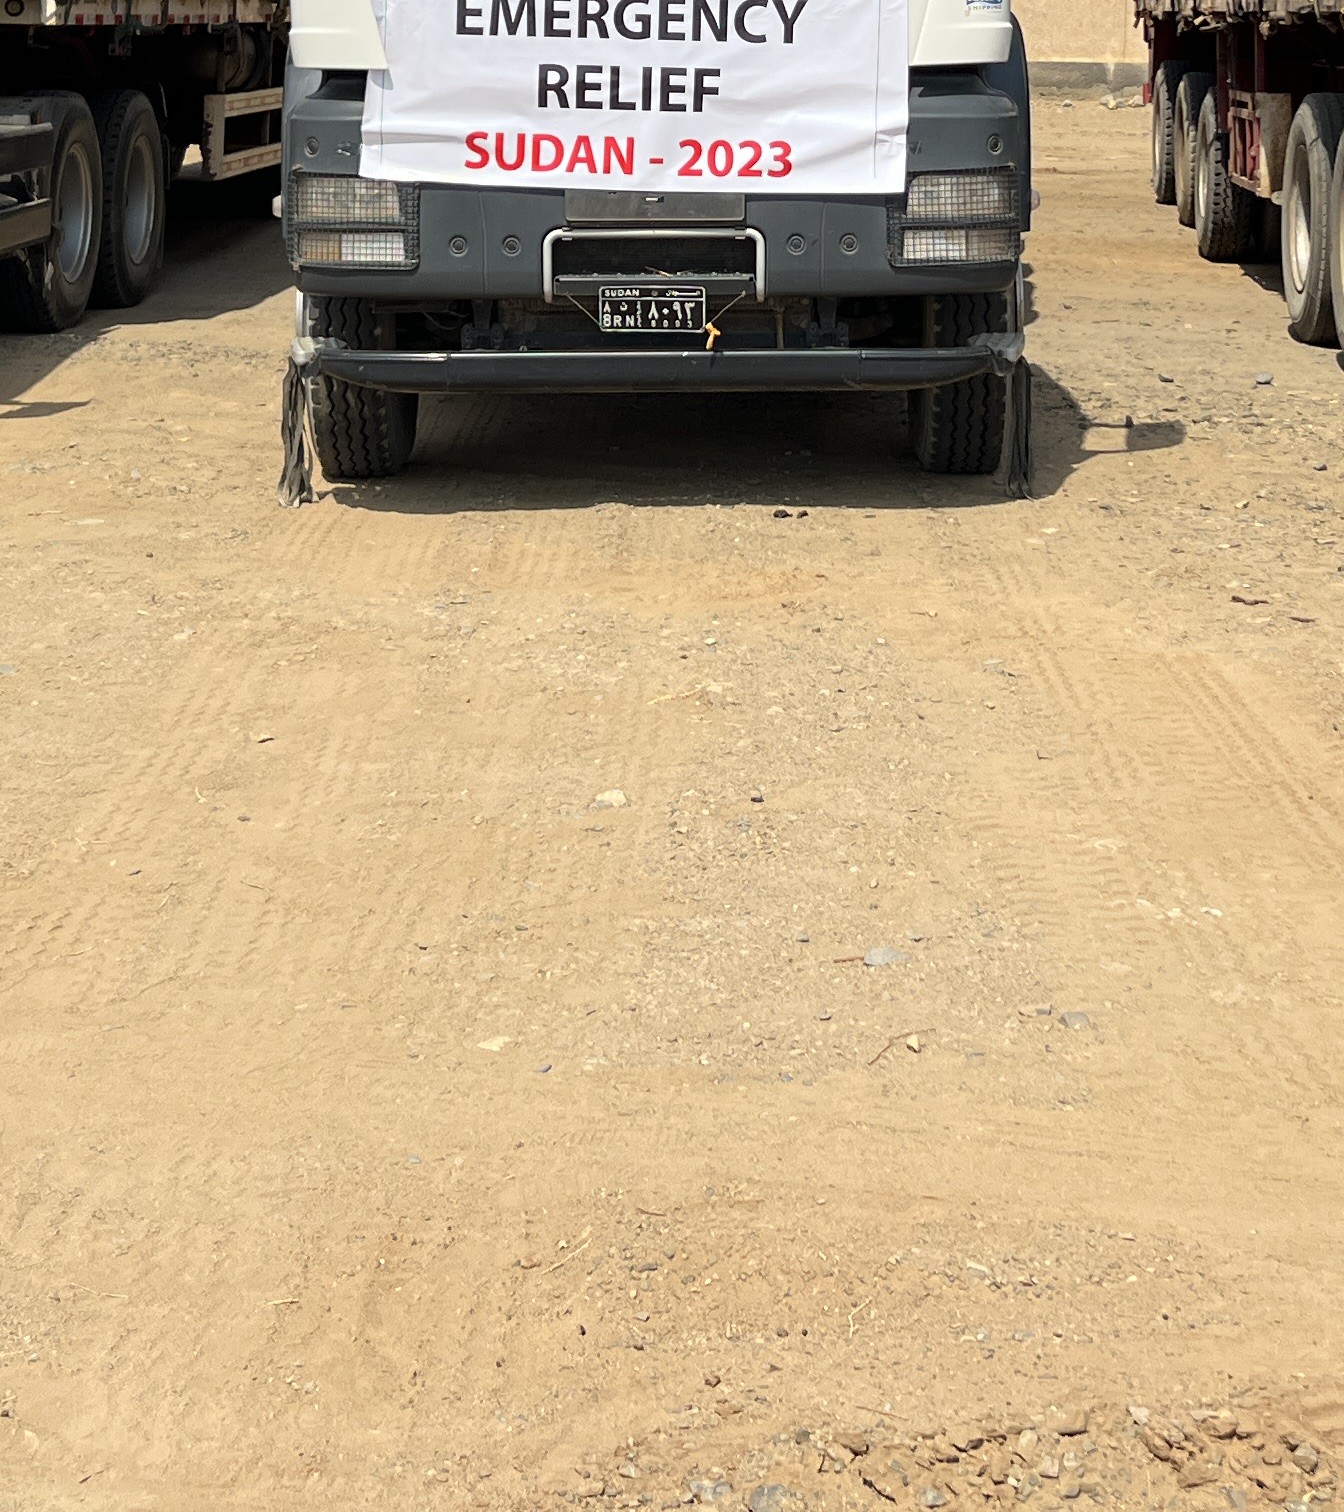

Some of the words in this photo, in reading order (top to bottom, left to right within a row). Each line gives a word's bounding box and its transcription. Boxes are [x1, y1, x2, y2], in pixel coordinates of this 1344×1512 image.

[538, 63, 721, 113] RELIEF
[464, 131, 635, 175] SUDAN
[677, 139, 793, 178] 2023
[604, 289, 640, 297] SUDAN
